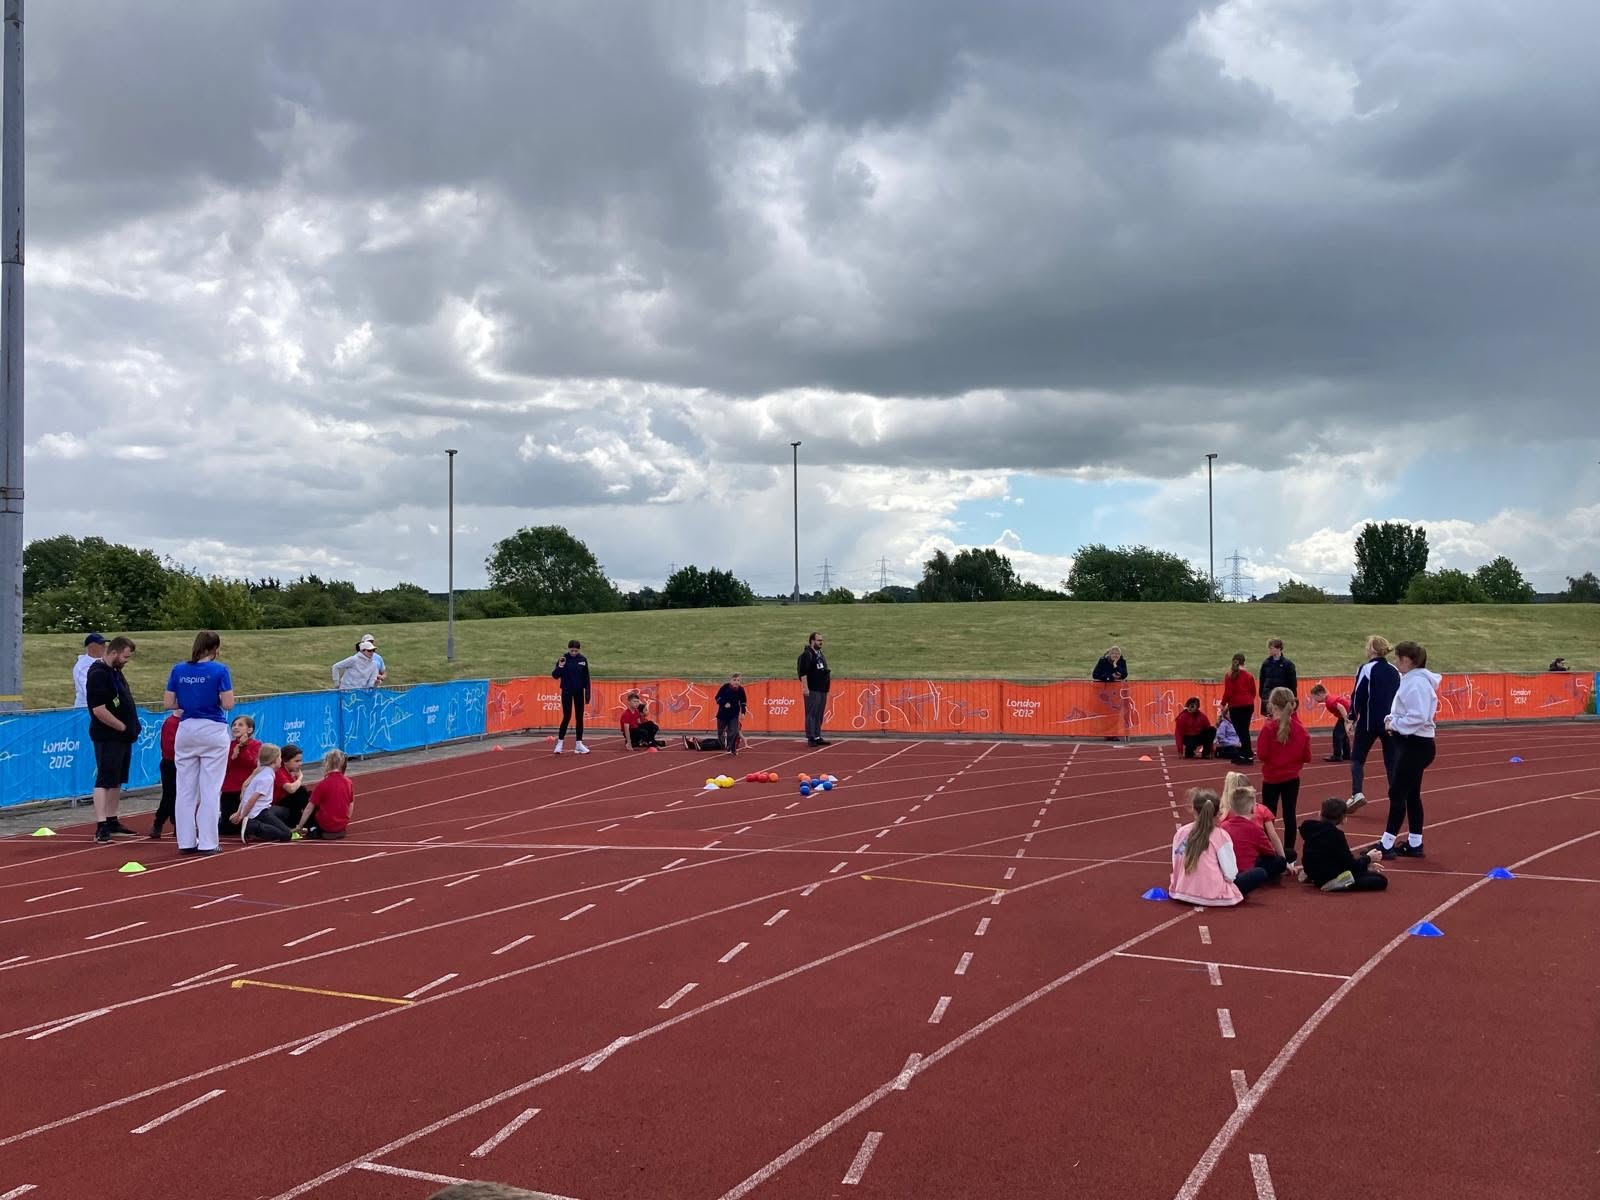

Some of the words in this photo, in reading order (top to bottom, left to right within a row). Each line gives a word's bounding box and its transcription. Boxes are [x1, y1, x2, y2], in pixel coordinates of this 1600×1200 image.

[179, 675, 206, 685] inspire
[536, 692, 562, 702] Londo
[763, 696, 795, 706] London
[1006, 698, 1041, 708] London
[769, 706, 789, 715] 2012
[1012, 708, 1034, 718] 2012
[283, 717, 305, 731] London
[286, 731, 301, 743] 2012
[42, 737, 81, 754] London
[49, 755, 74, 769] 2012
